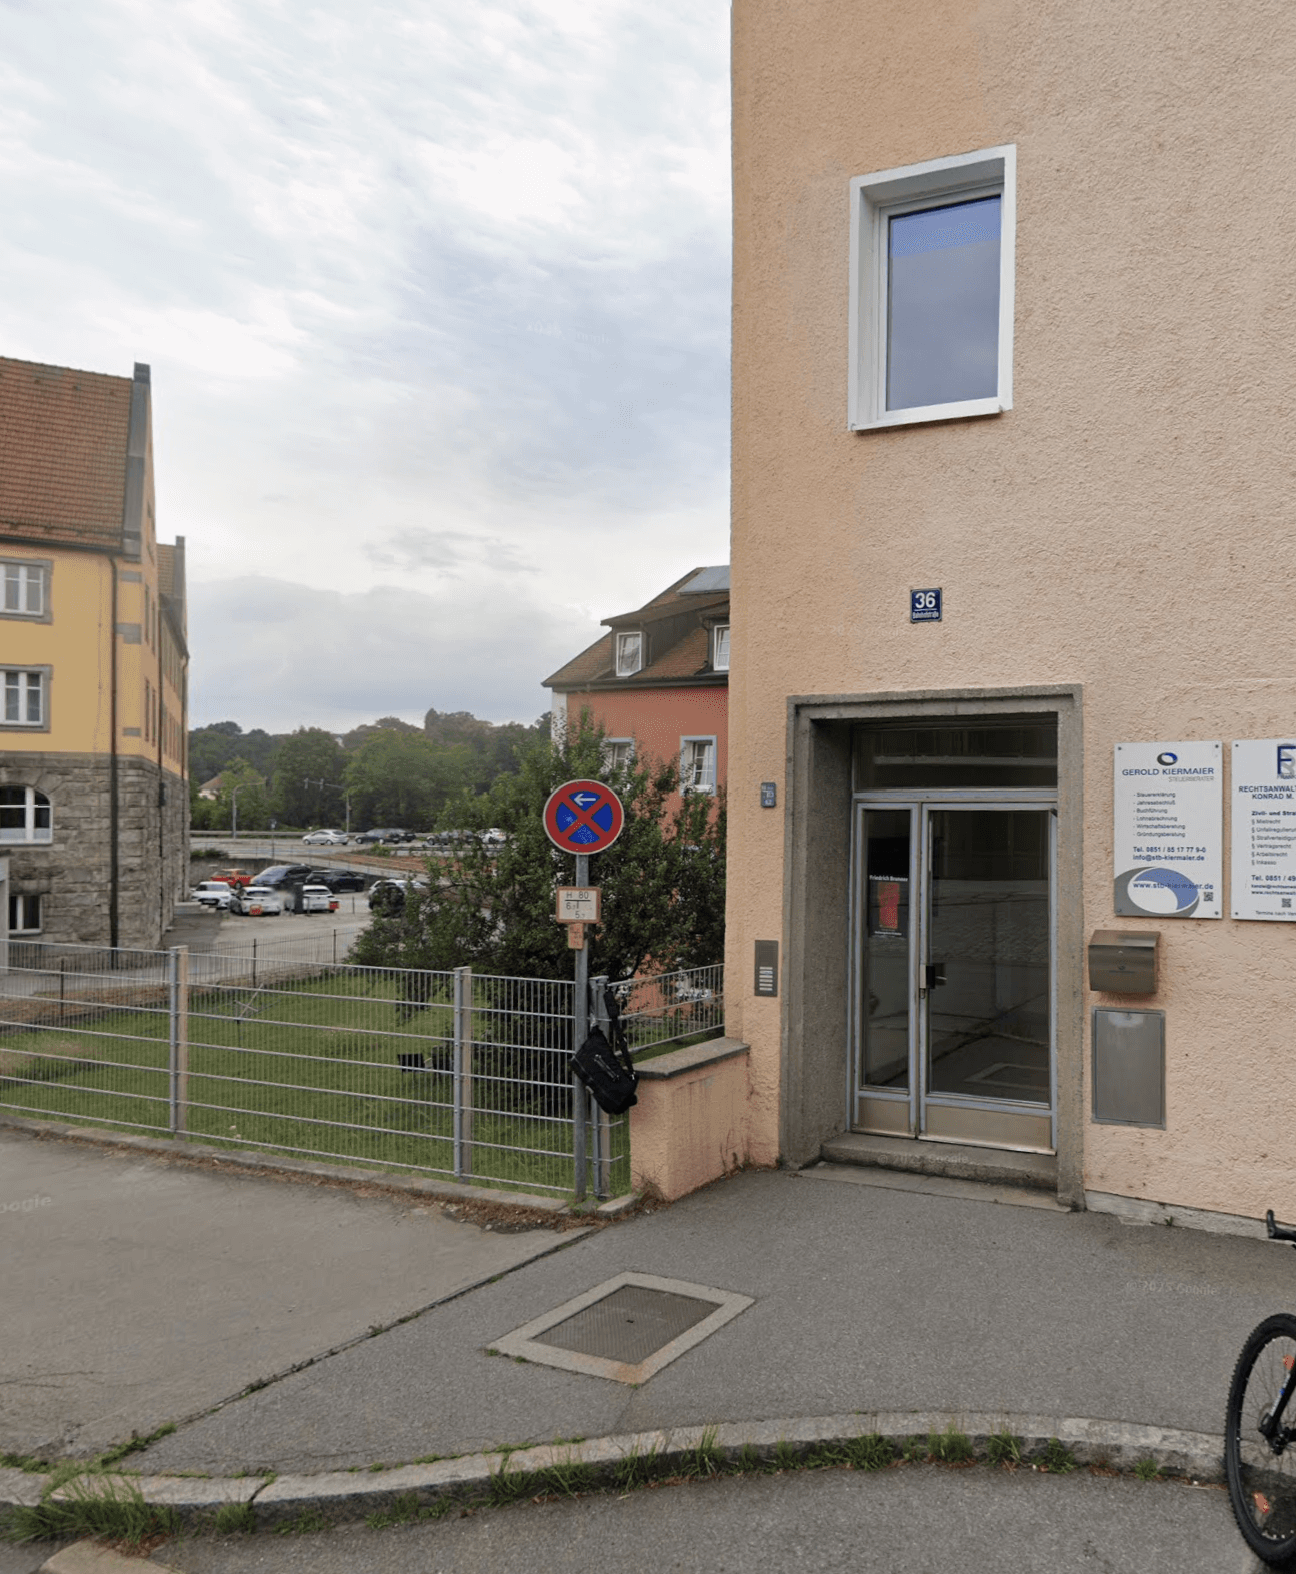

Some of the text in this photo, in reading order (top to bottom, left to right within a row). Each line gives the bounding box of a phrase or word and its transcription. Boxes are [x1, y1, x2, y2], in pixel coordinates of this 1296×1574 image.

[915, 592, 936, 608] 36
[1162, 767, 1215, 775] KIERMAIER
[1133, 882, 1214, 890] www.stb-kiermaier.de
